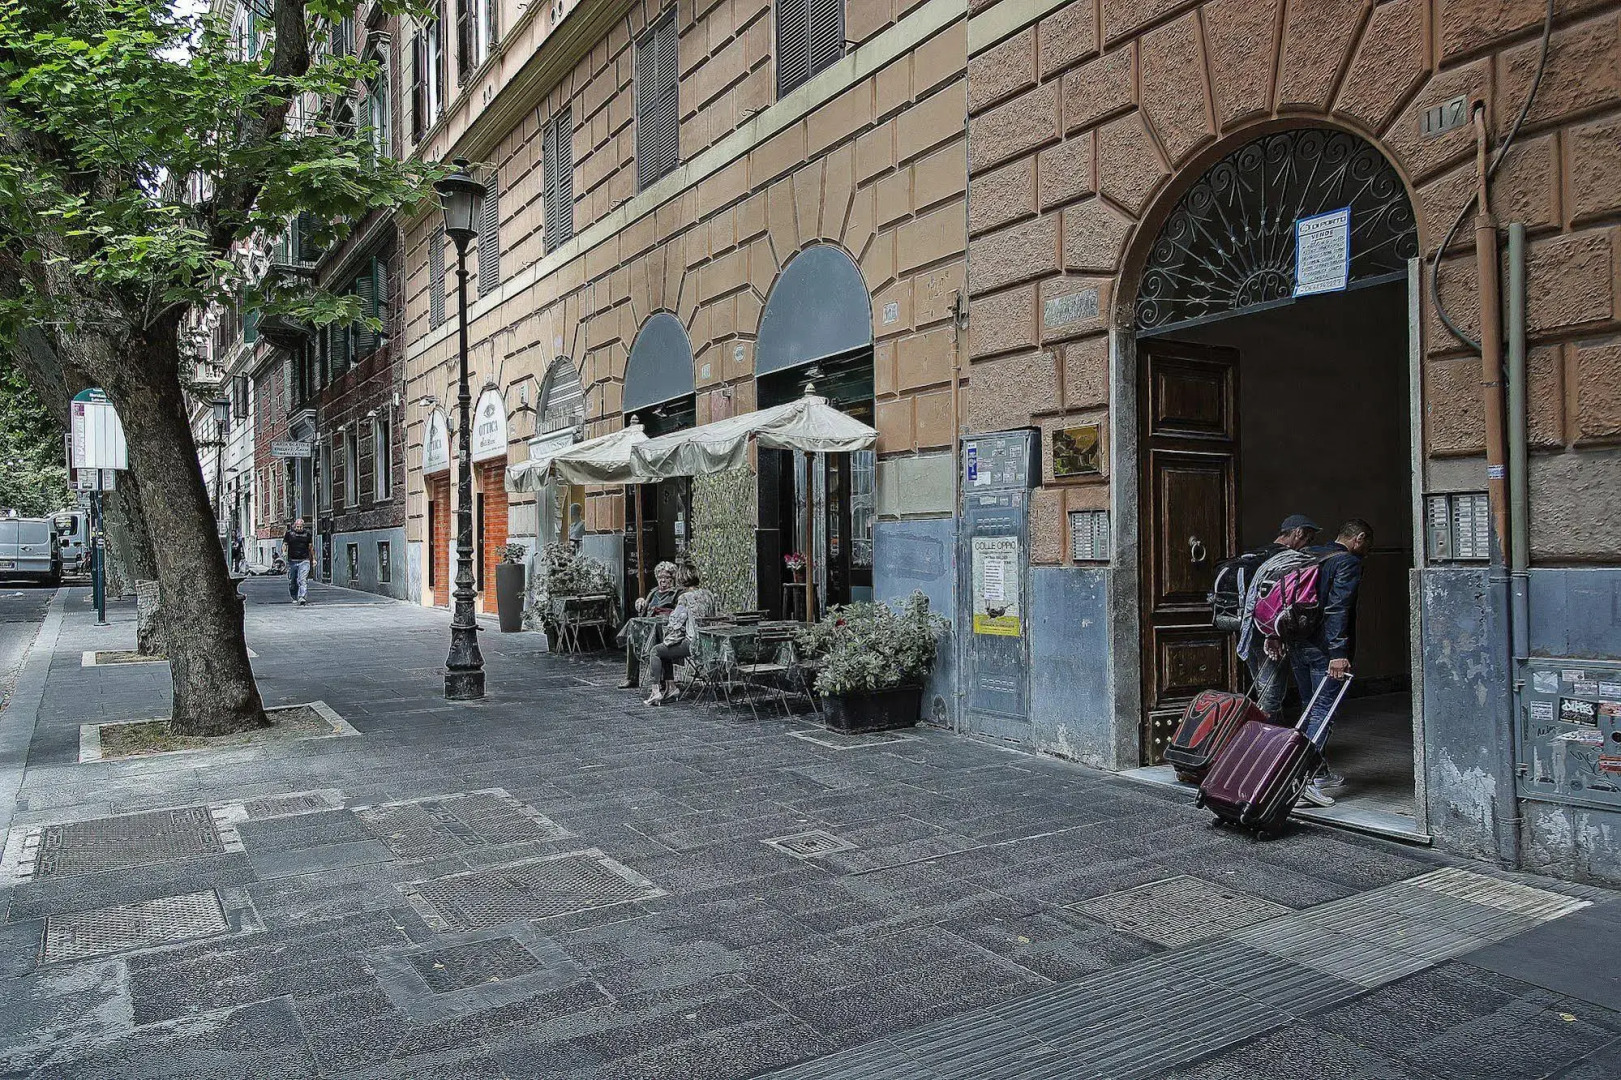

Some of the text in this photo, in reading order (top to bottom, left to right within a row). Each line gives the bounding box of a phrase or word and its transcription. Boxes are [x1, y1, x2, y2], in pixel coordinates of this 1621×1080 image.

[1425, 98, 1464, 133] 117
[1311, 229, 1334, 240] VENDE
[478, 420, 499, 437] OTTICA
[974, 540, 1016, 551] COLLE OPPIO
